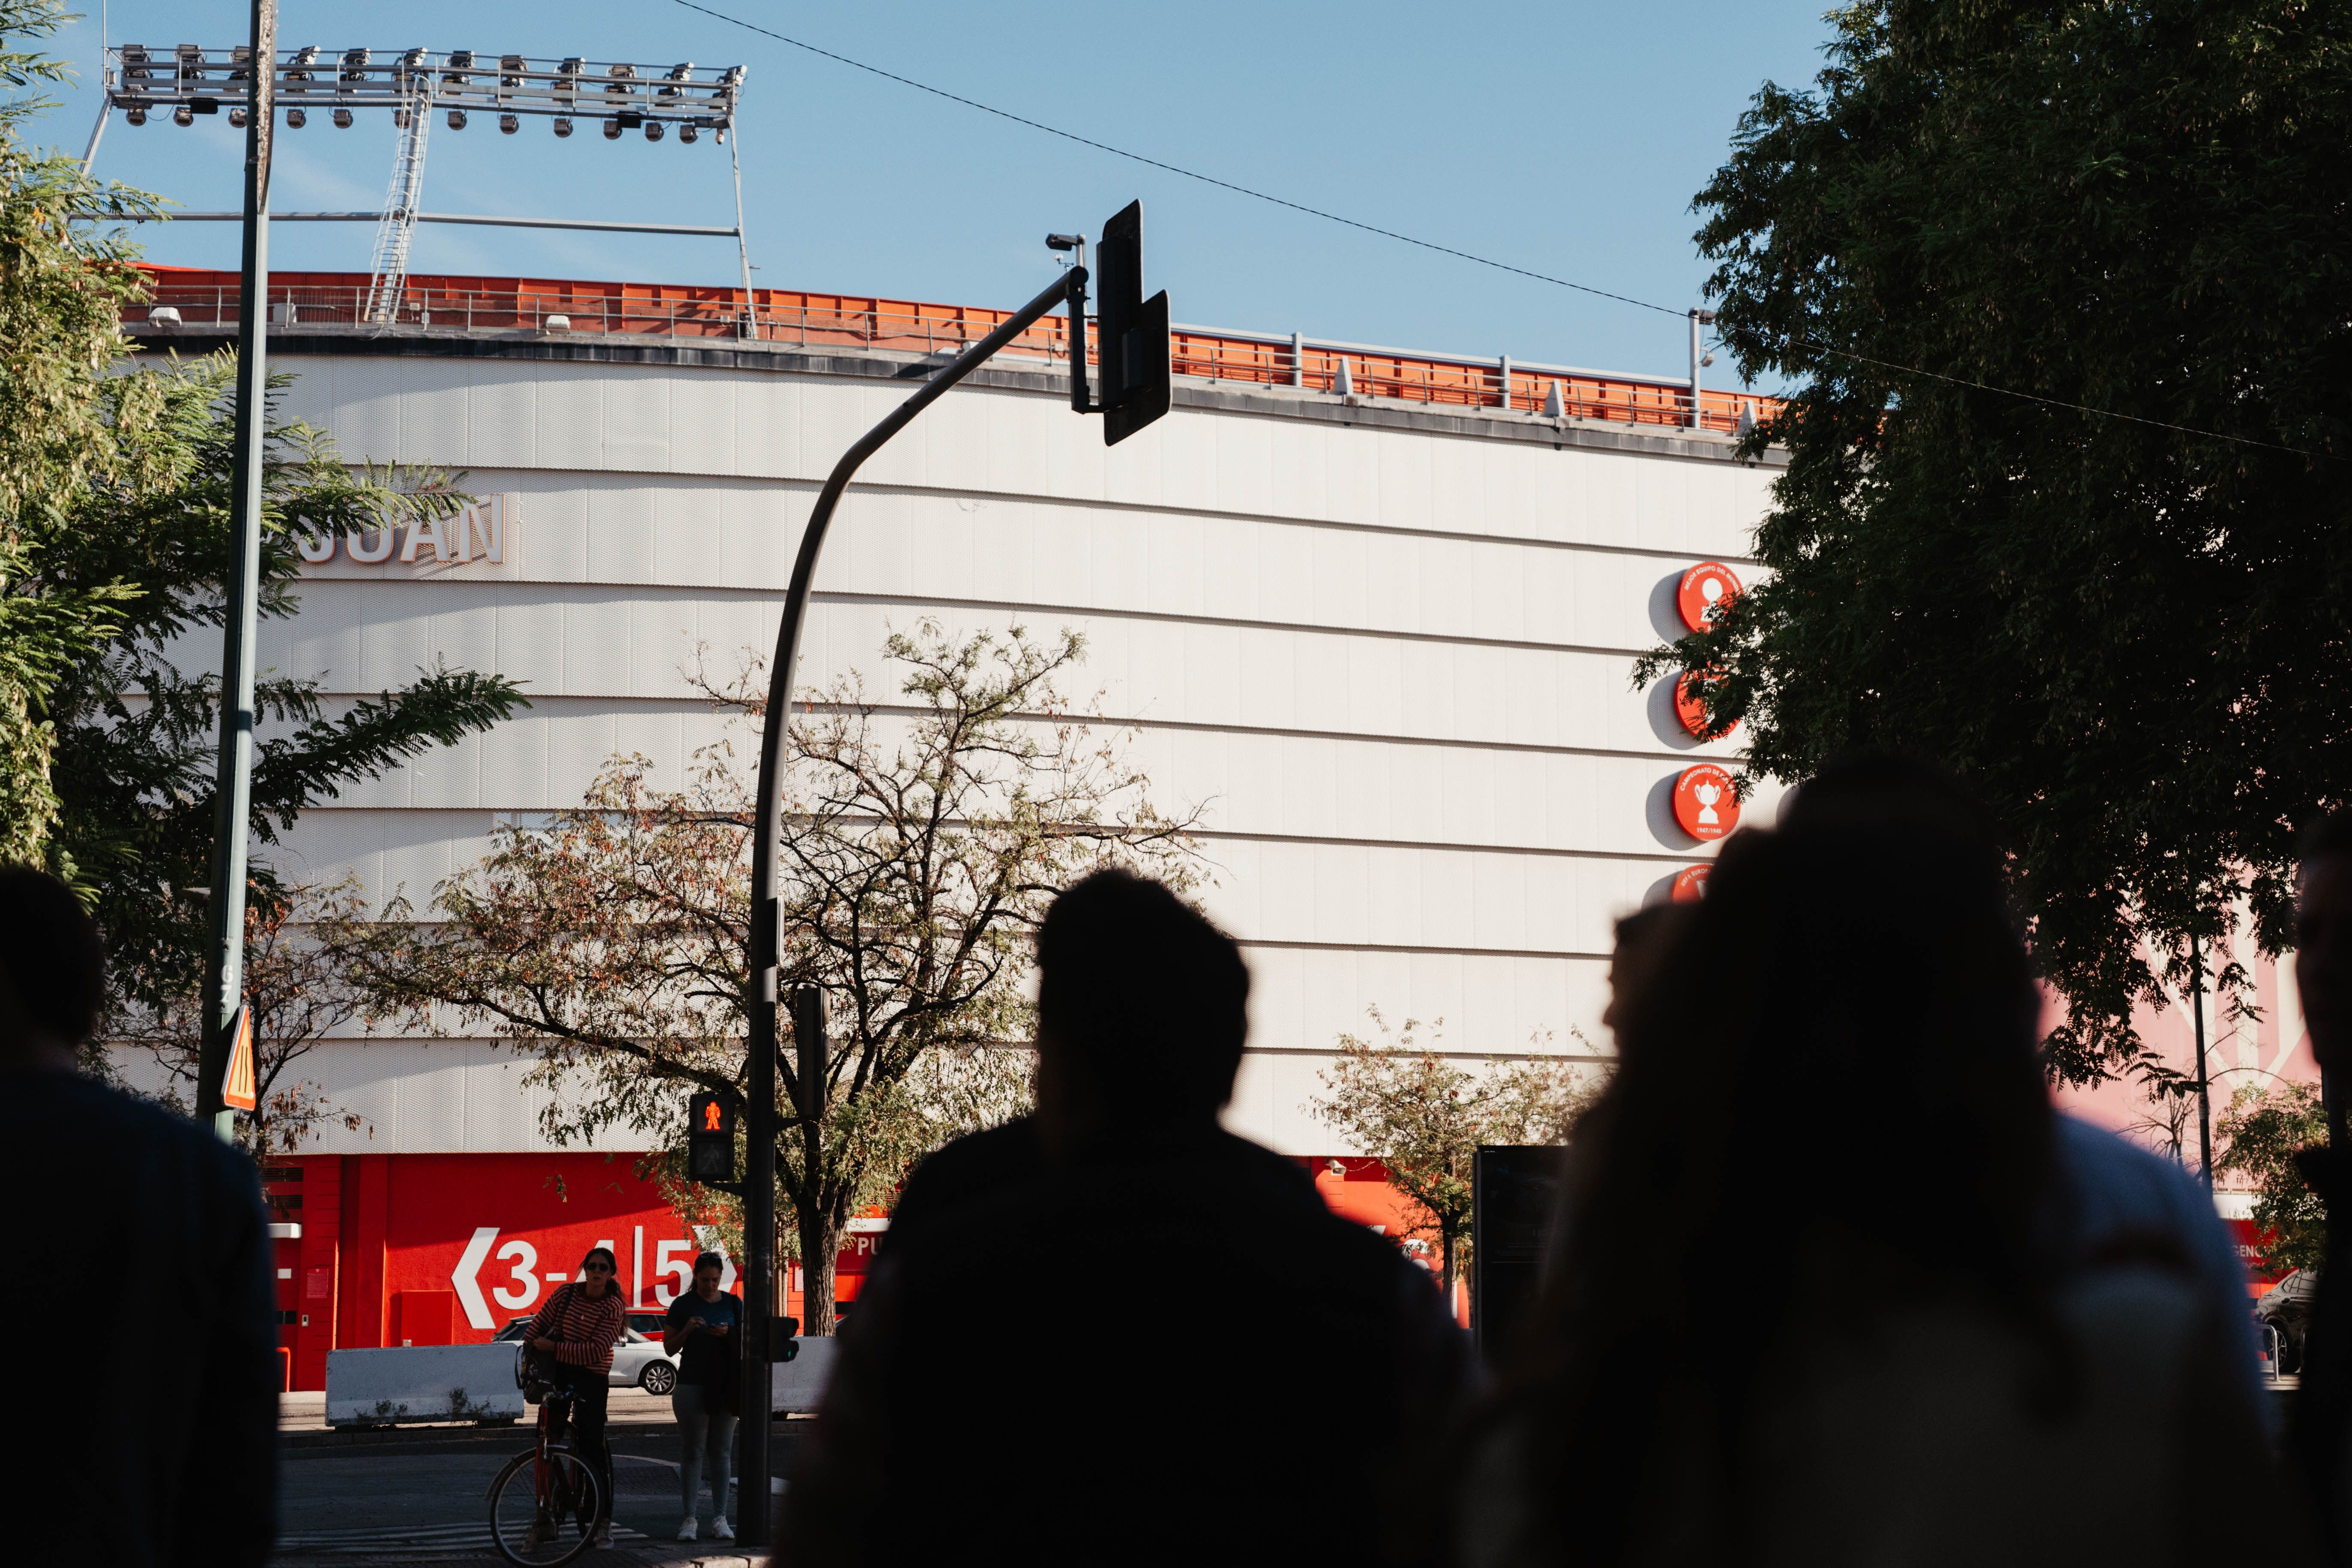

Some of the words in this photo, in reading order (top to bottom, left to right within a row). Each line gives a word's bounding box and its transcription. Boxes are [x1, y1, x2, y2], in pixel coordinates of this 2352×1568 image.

[1696, 565, 1716, 574] EQUIPO
[1716, 567, 1726, 575] DEL
[1680, 767, 1712, 791] CAMPEONATO
